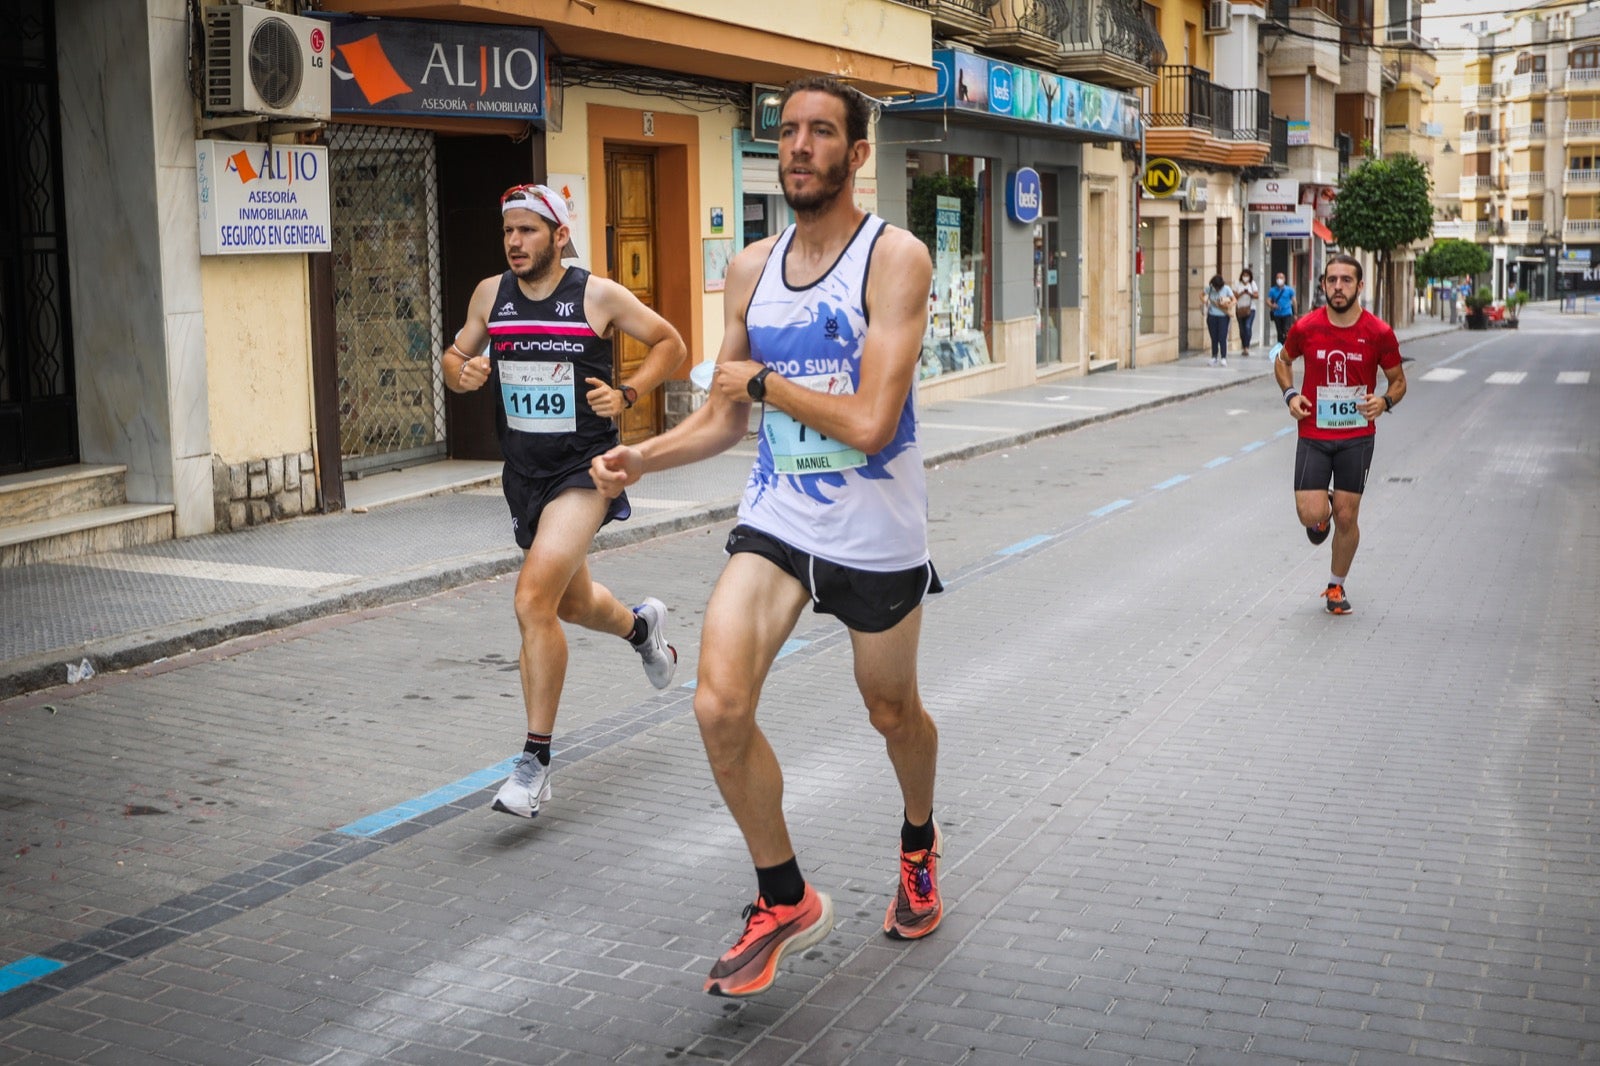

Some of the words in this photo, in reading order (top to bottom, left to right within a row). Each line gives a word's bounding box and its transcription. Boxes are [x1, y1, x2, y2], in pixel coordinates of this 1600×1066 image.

[312, 57, 323, 68] LG
[420, 42, 538, 96] ALJIO
[421, 97, 467, 111] ASESORÍA
[469, 103, 475, 111] e
[476, 101, 538, 113] INMOBILIARIA
[258, 150, 318, 187] ALJIO
[1147, 170, 1175, 187] IN
[248, 189, 297, 204] ASESORÍA
[239, 208, 308, 221] INMOBILIARIA
[221, 225, 266, 246] SEGUROS
[268, 225, 281, 245] EN
[283, 225, 327, 245] GENERAL
[1583, 268, 1600, 281] KI
[805, 359, 853, 374] SUMA
[510, 393, 565, 415] 1149
[1330, 401, 1358, 416] 163
[796, 456, 832, 470] MANUEL
